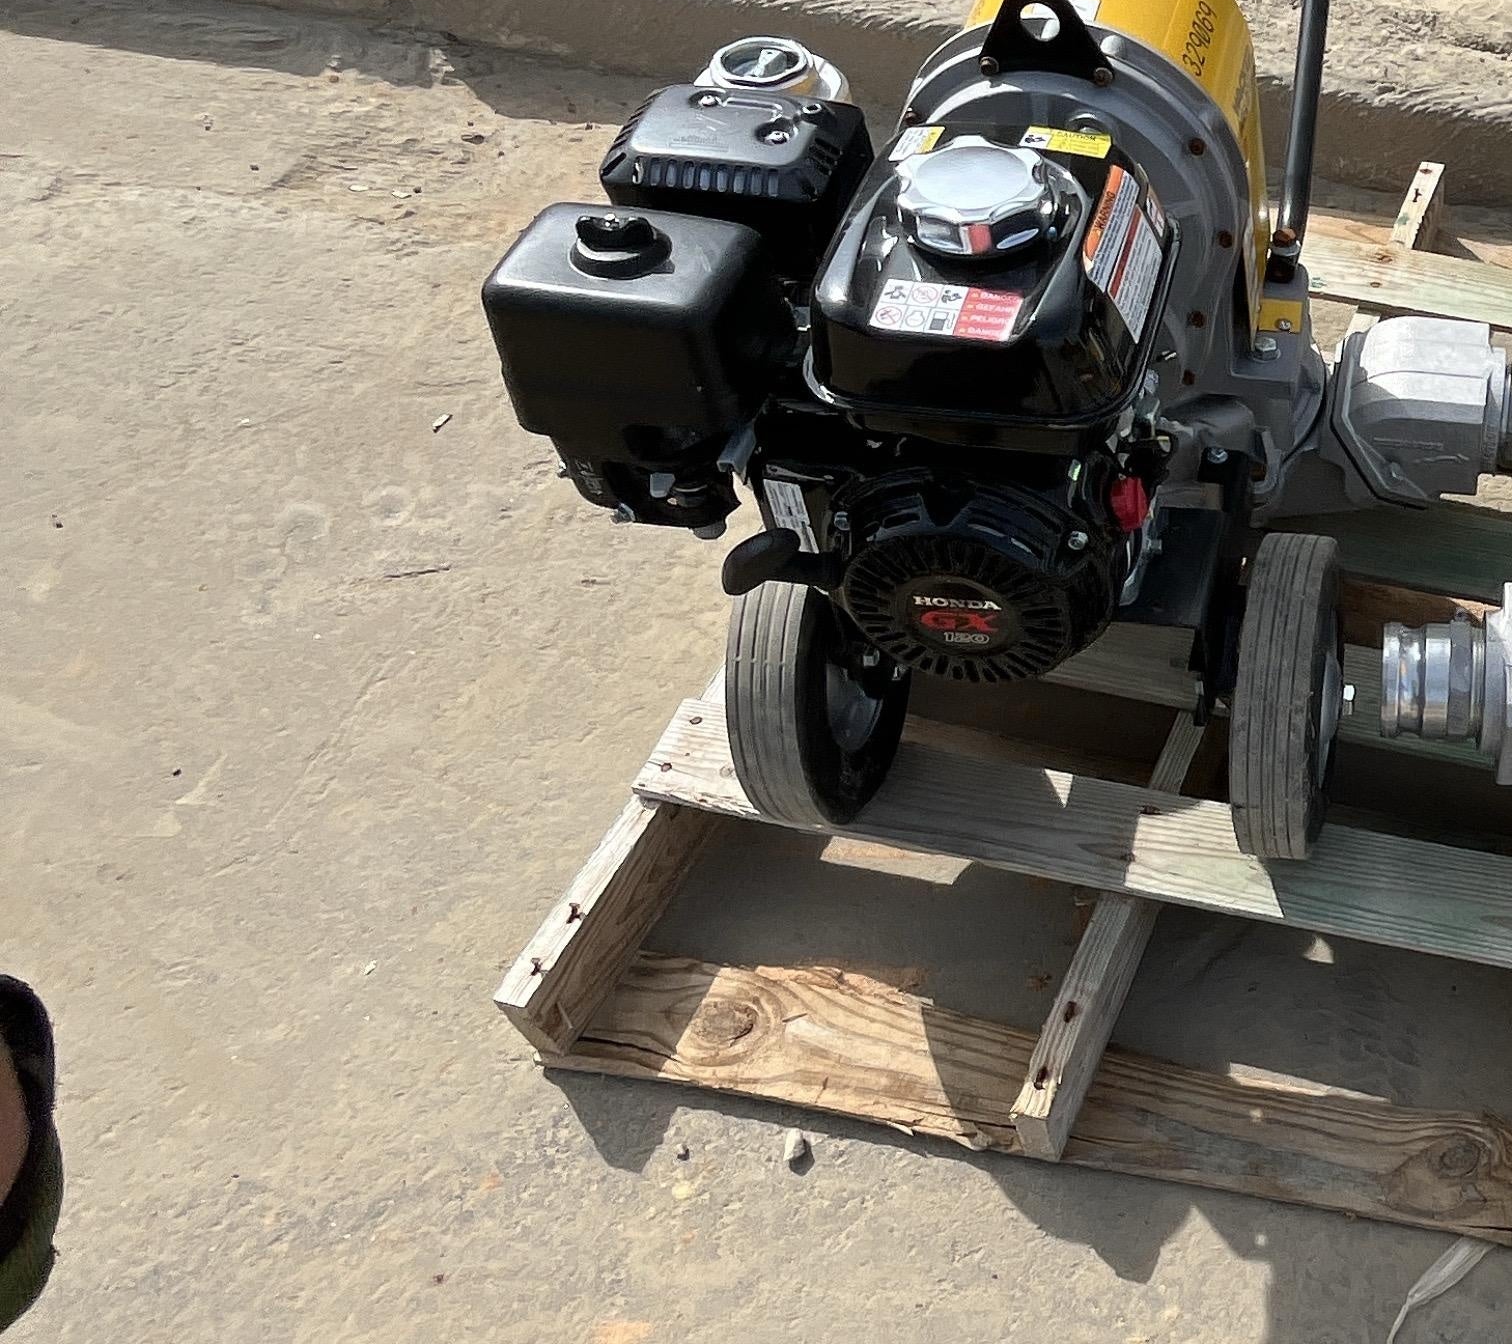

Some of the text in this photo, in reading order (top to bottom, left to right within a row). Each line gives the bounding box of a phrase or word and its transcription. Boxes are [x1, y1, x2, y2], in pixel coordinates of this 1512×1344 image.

[1181, 0, 1217, 78] 329069
[913, 595, 1001, 610] HONDA
[920, 611, 999, 632] GX
[943, 631, 990, 645] 120
